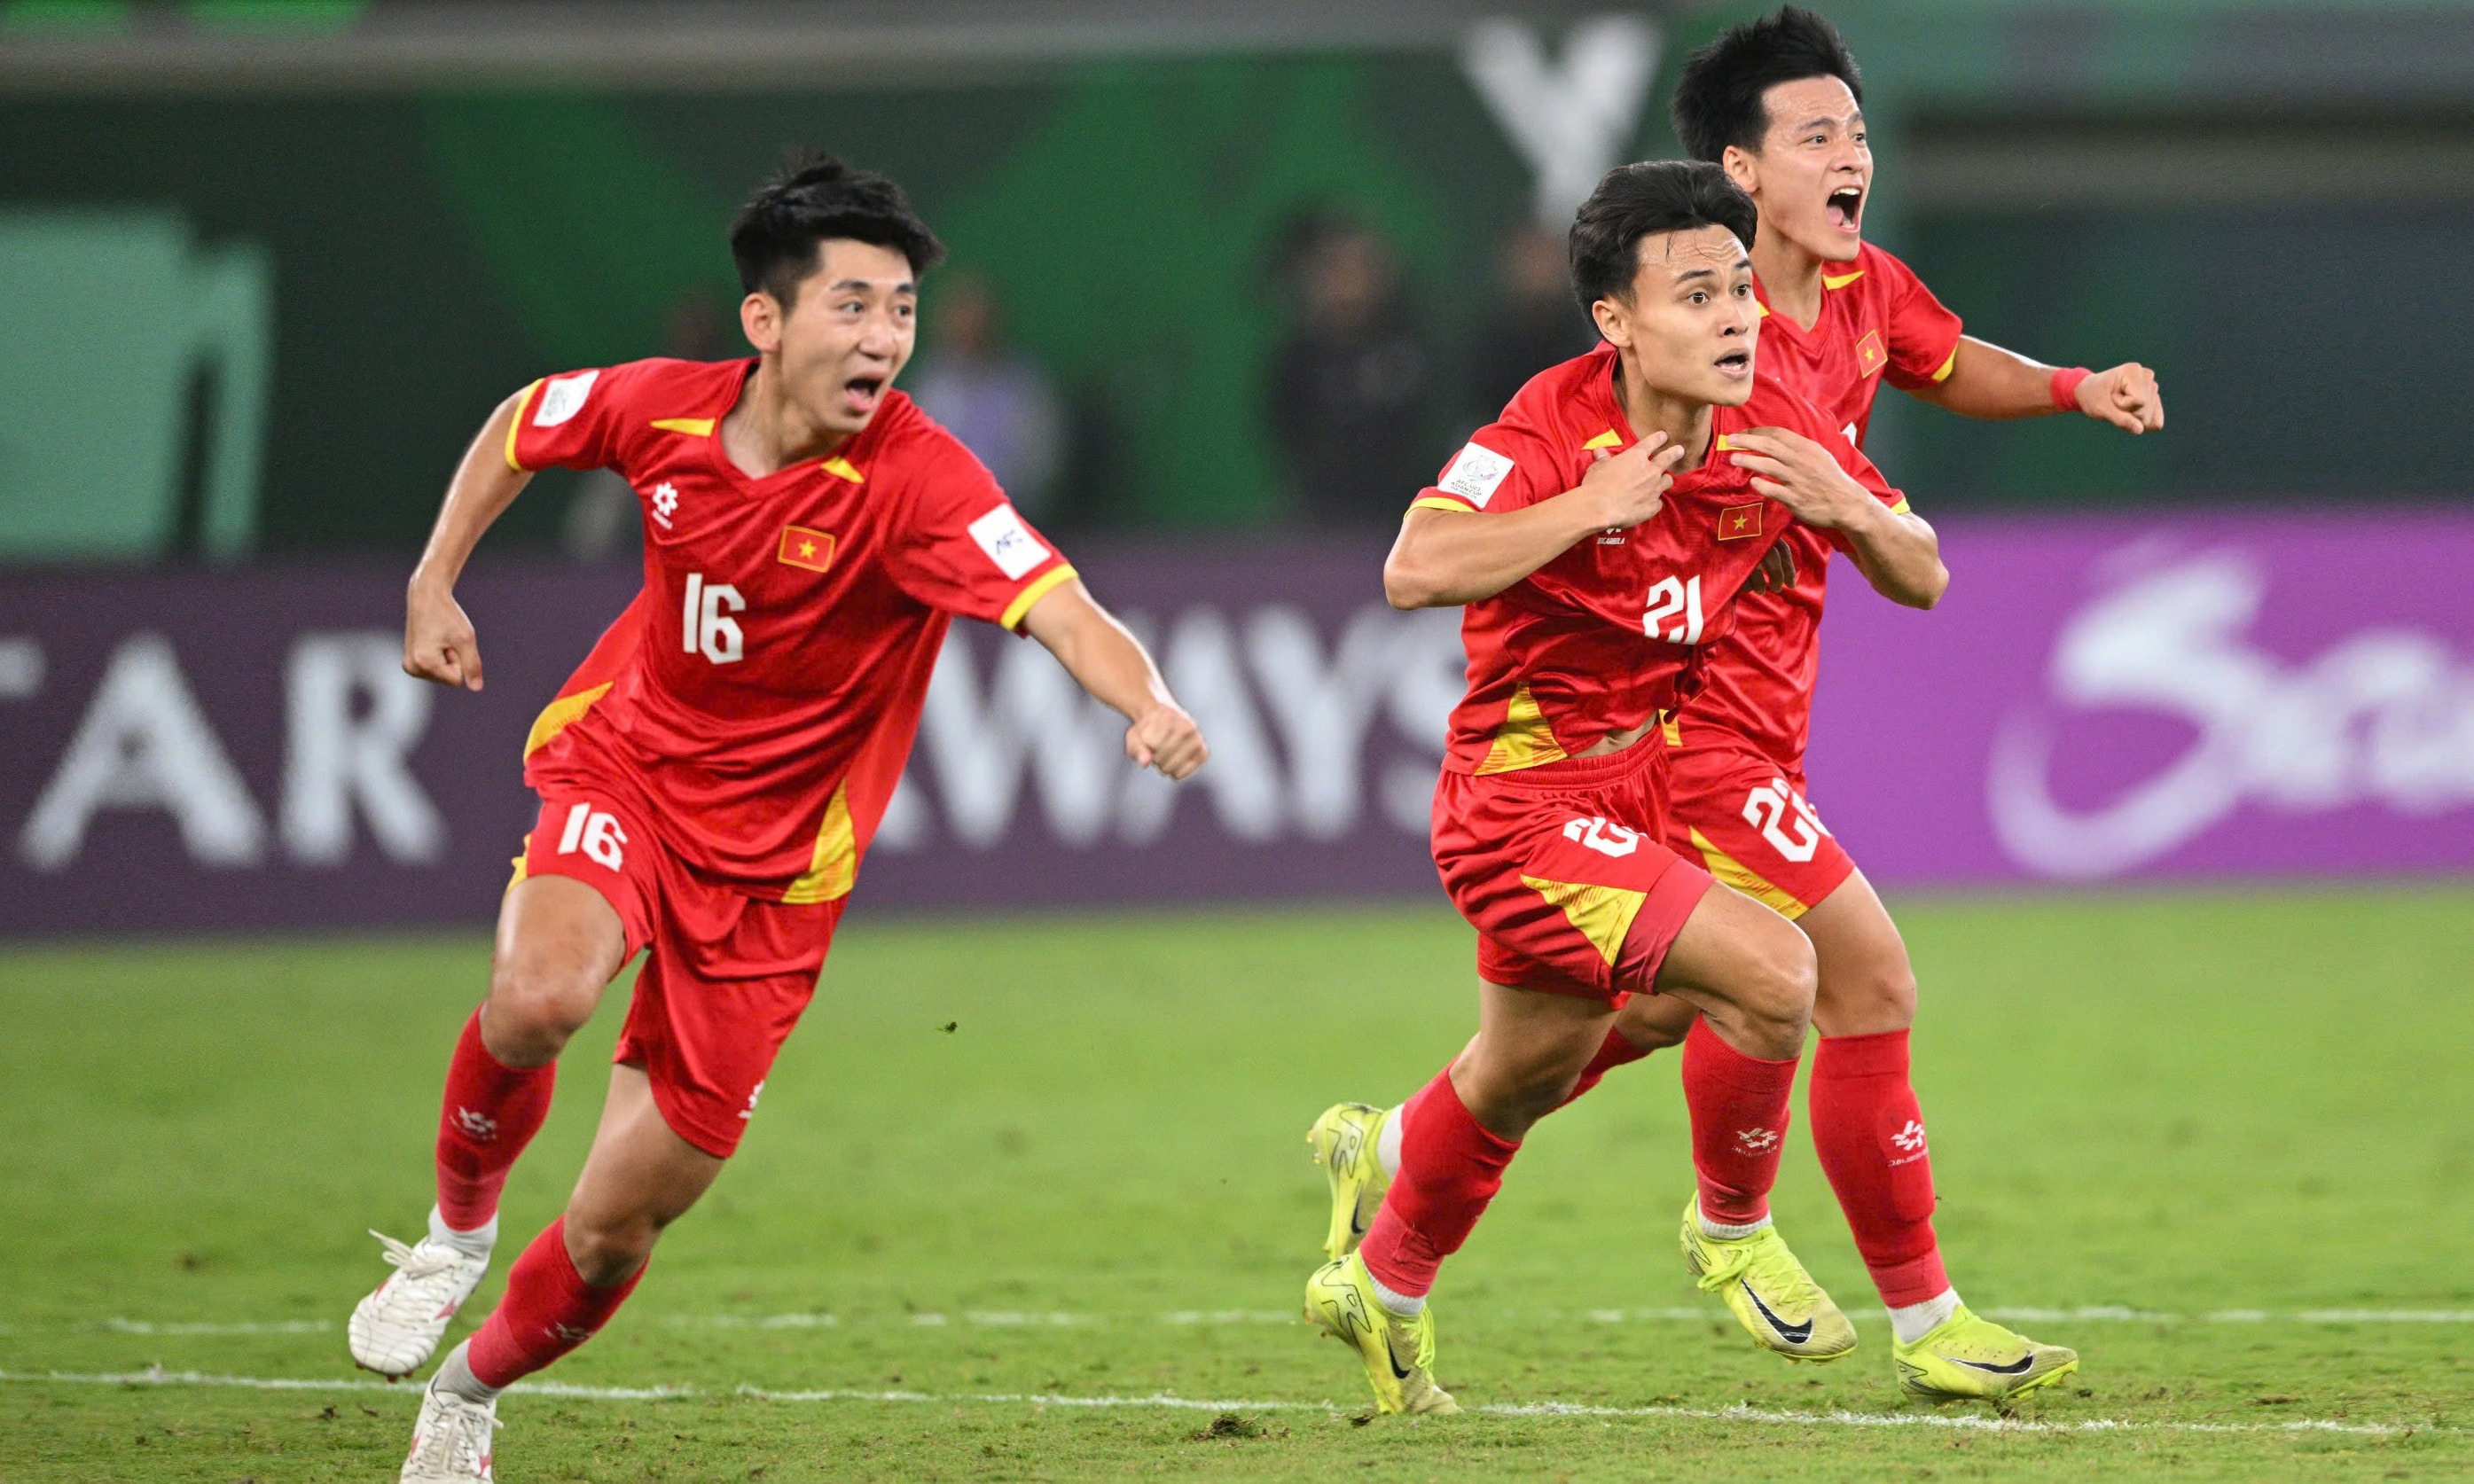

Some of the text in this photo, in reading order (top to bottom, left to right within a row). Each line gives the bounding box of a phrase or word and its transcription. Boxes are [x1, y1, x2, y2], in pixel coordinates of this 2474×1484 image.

[683, 572, 747, 665] 16
[1642, 574, 1704, 645] 21
[557, 801, 628, 873] 16
[1562, 816, 1648, 858] 2
